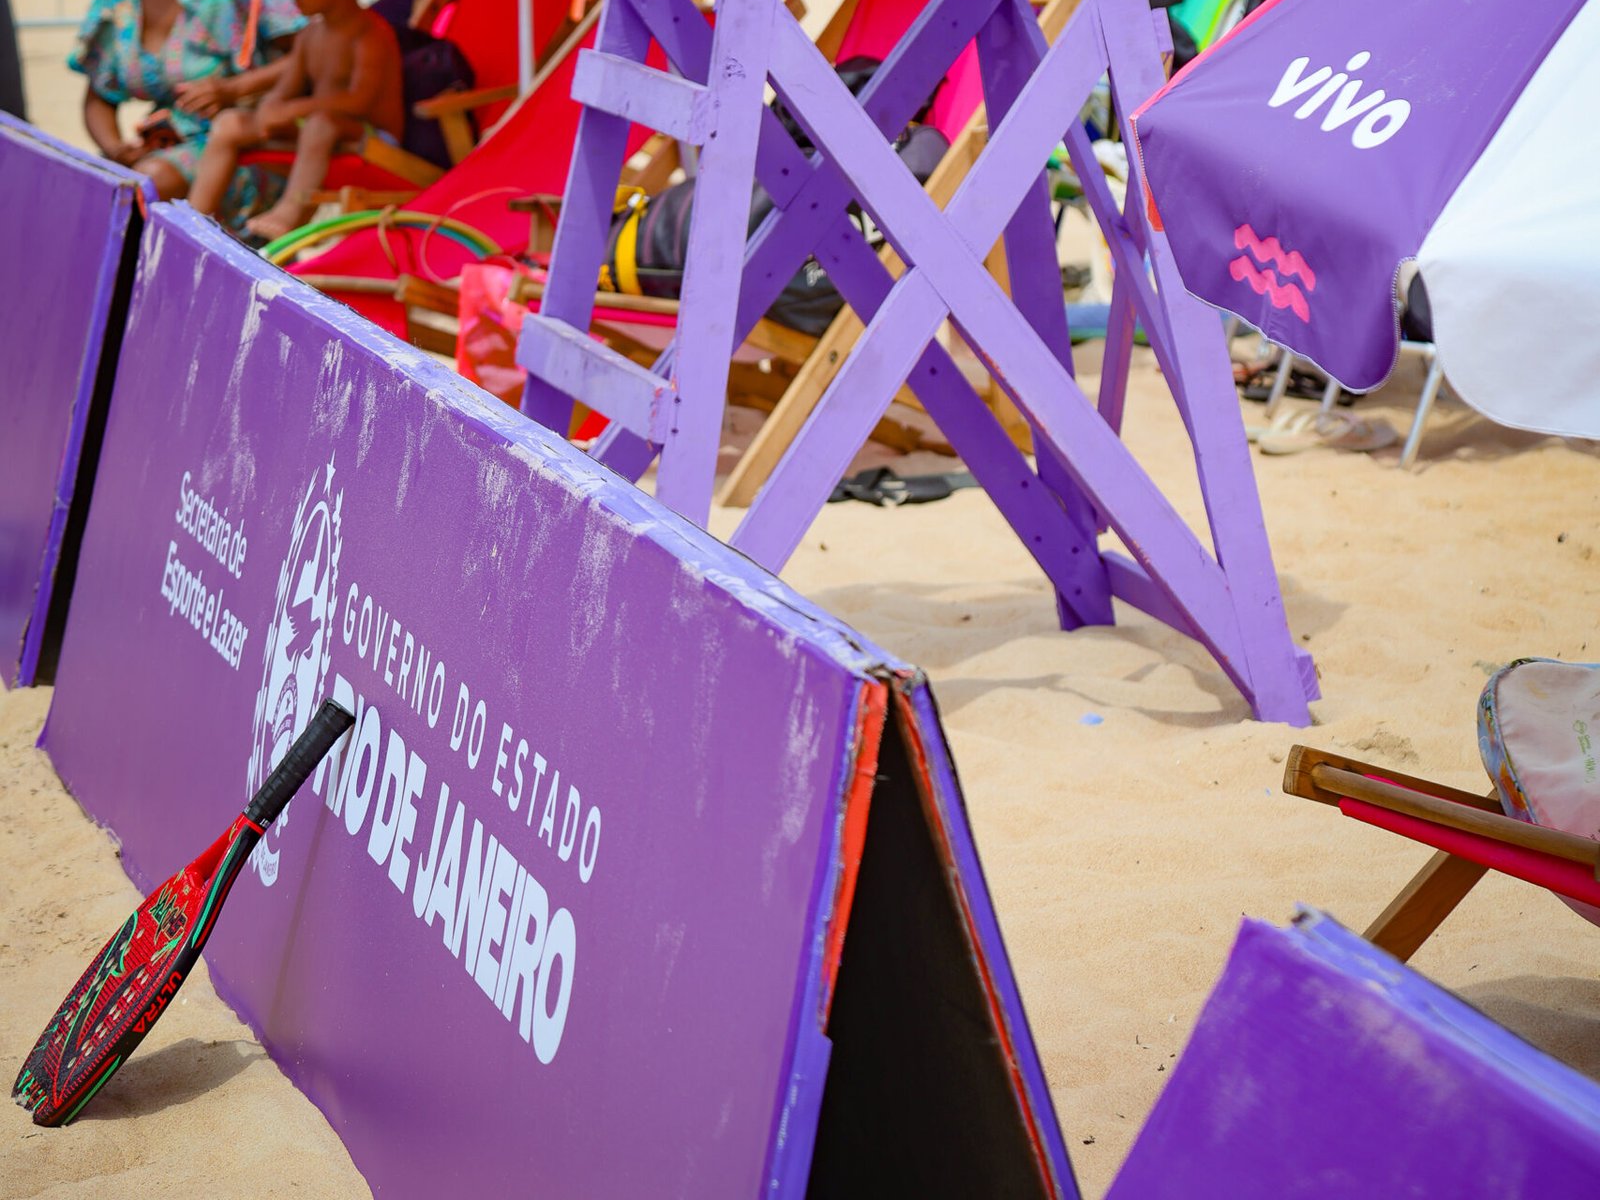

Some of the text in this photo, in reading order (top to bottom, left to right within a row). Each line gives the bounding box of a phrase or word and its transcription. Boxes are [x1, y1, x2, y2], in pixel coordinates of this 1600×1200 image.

[1267, 50, 1412, 149] vivo
[175, 470, 248, 580] Secretaria de
[160, 540, 249, 671] Esporte e Lazer
[343, 582, 445, 729] GOVERNO
[449, 681, 487, 770] DO
[491, 721, 601, 884] ESTADO
[367, 727, 427, 894] DE
[413, 781, 576, 1065] JANEIRO
[132, 971, 183, 1033] ULTRA
